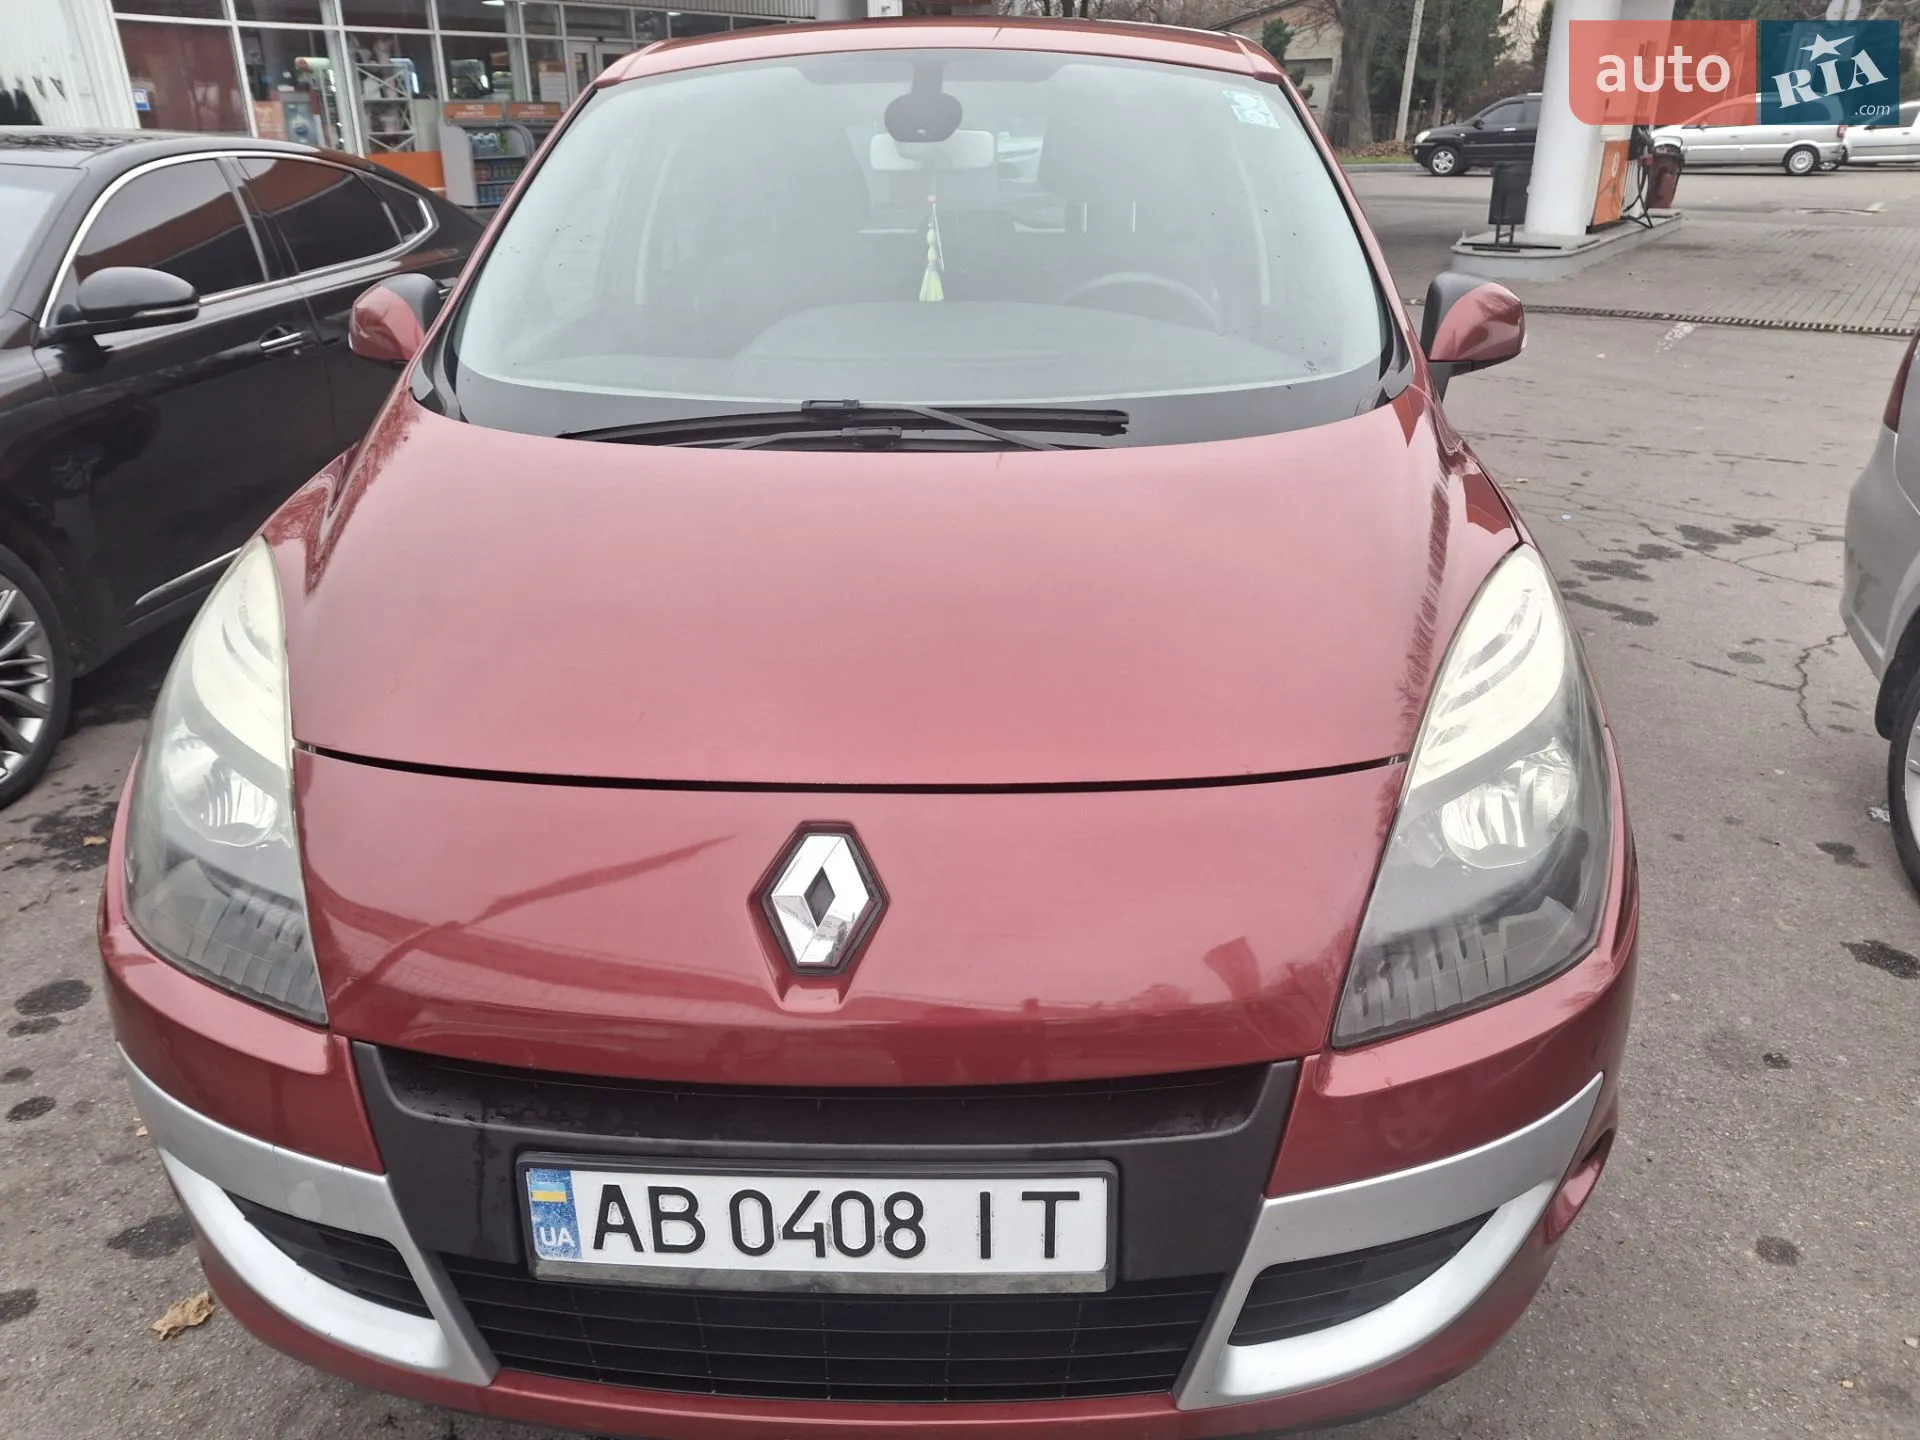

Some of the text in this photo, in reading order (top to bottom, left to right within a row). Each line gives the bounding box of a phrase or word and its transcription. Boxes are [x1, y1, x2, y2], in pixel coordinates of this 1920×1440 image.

[539, 1225, 575, 1248] UA
[593, 1184, 1081, 1259] AB 0408 IT
